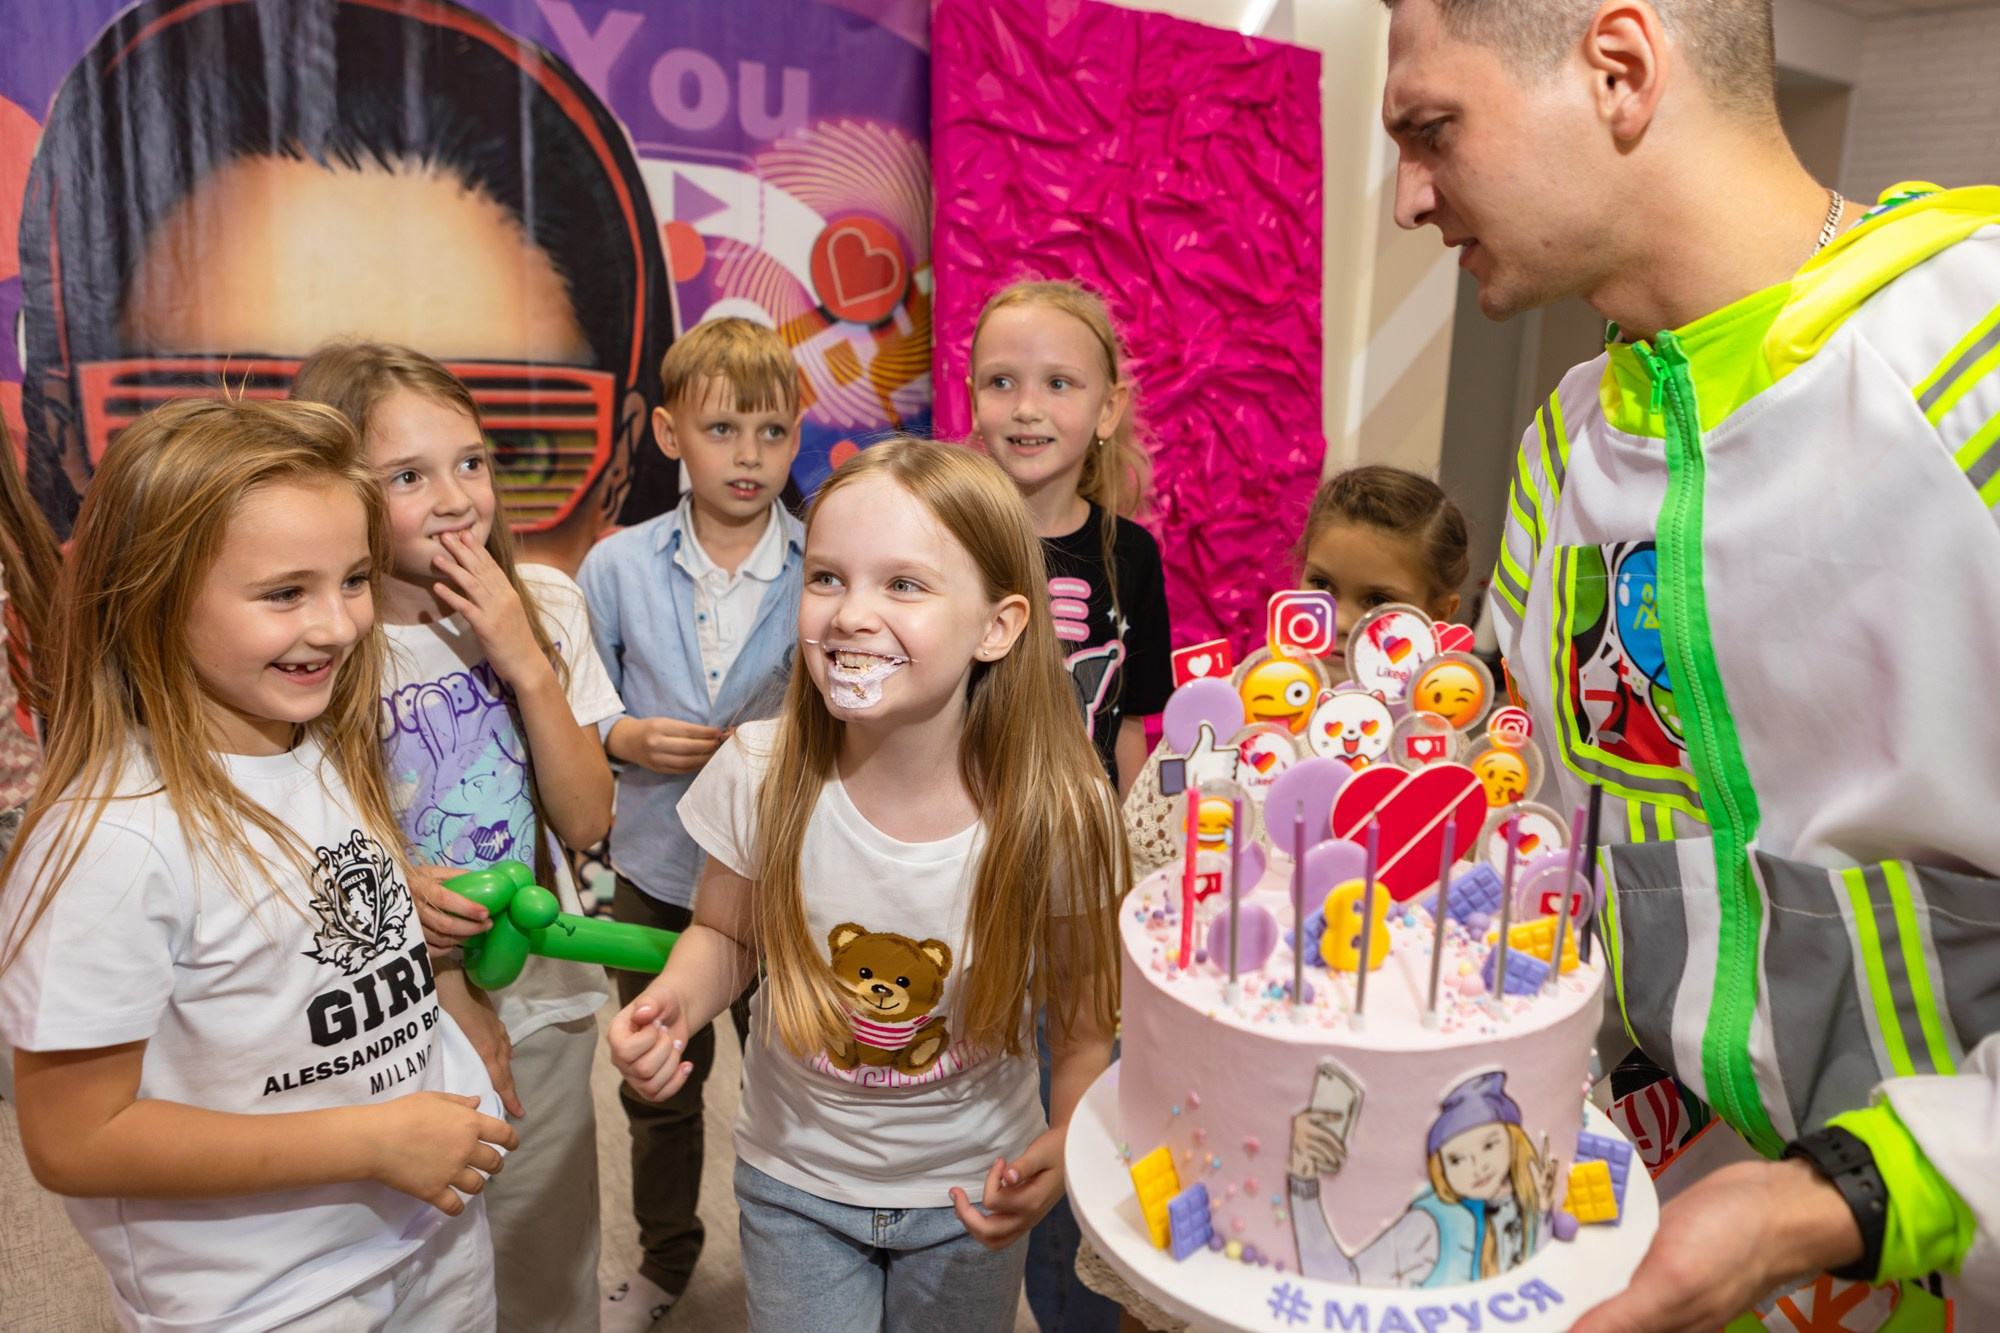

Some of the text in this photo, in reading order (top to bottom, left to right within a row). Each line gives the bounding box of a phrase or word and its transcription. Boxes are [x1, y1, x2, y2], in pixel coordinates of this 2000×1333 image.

[535, 0, 811, 140] You
[1376, 666, 1408, 680] Likee
[341, 871, 368, 889] BORELLI
[1320, 878, 1391, 973] 8
[262, 1020, 419, 1097] ALESSANDRO
[1267, 1278, 1564, 1333] #МАРУСЯ
